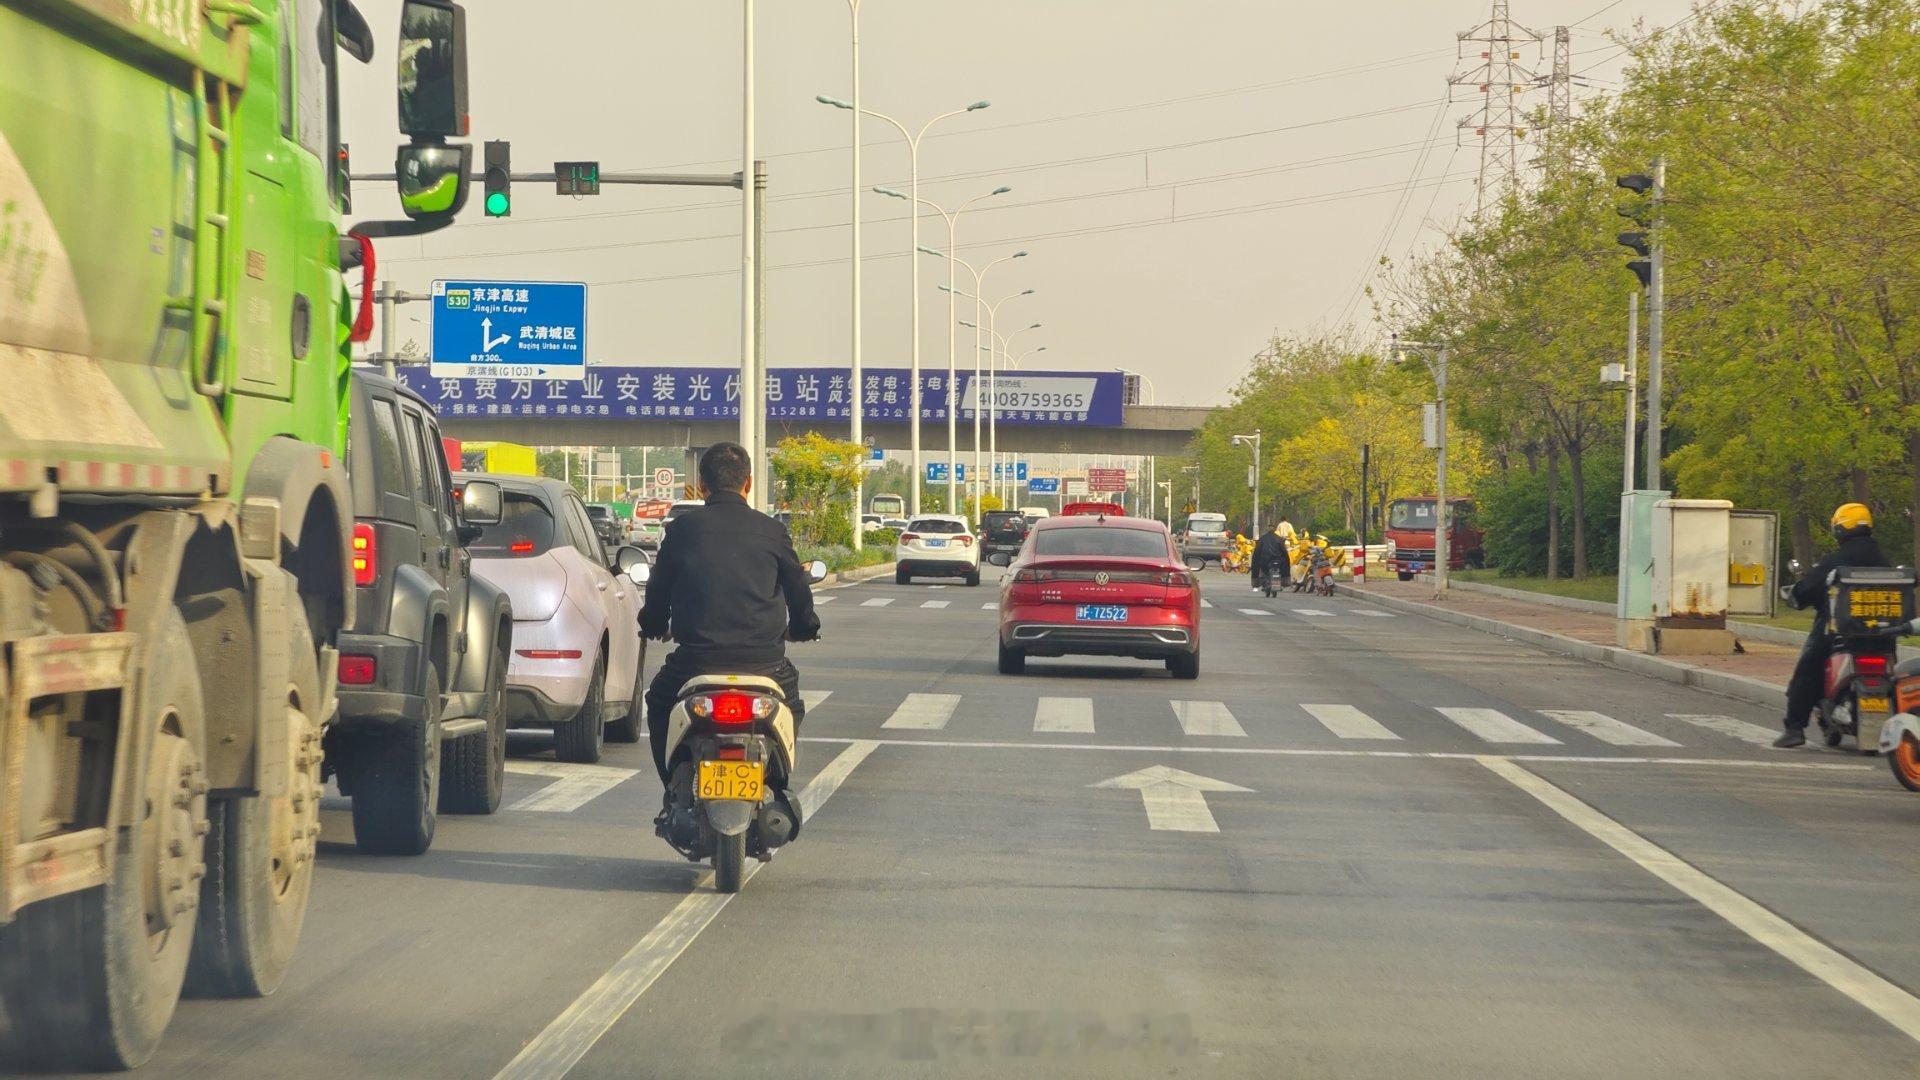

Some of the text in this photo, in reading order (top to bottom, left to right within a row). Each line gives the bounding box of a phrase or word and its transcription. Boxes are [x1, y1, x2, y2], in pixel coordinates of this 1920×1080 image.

[572, 166, 596, 191] 14
[449, 296, 468, 306] S30
[472, 287, 530, 302] 京津高速
[472, 304, 528, 314] Jingjin Expwy
[519, 326, 577, 340] 武清城区
[542, 342, 561, 350] Urban
[562, 342, 577, 350] Area
[980, 392, 1083, 408] 4008759365
[702, 779, 759, 797] 6D129
